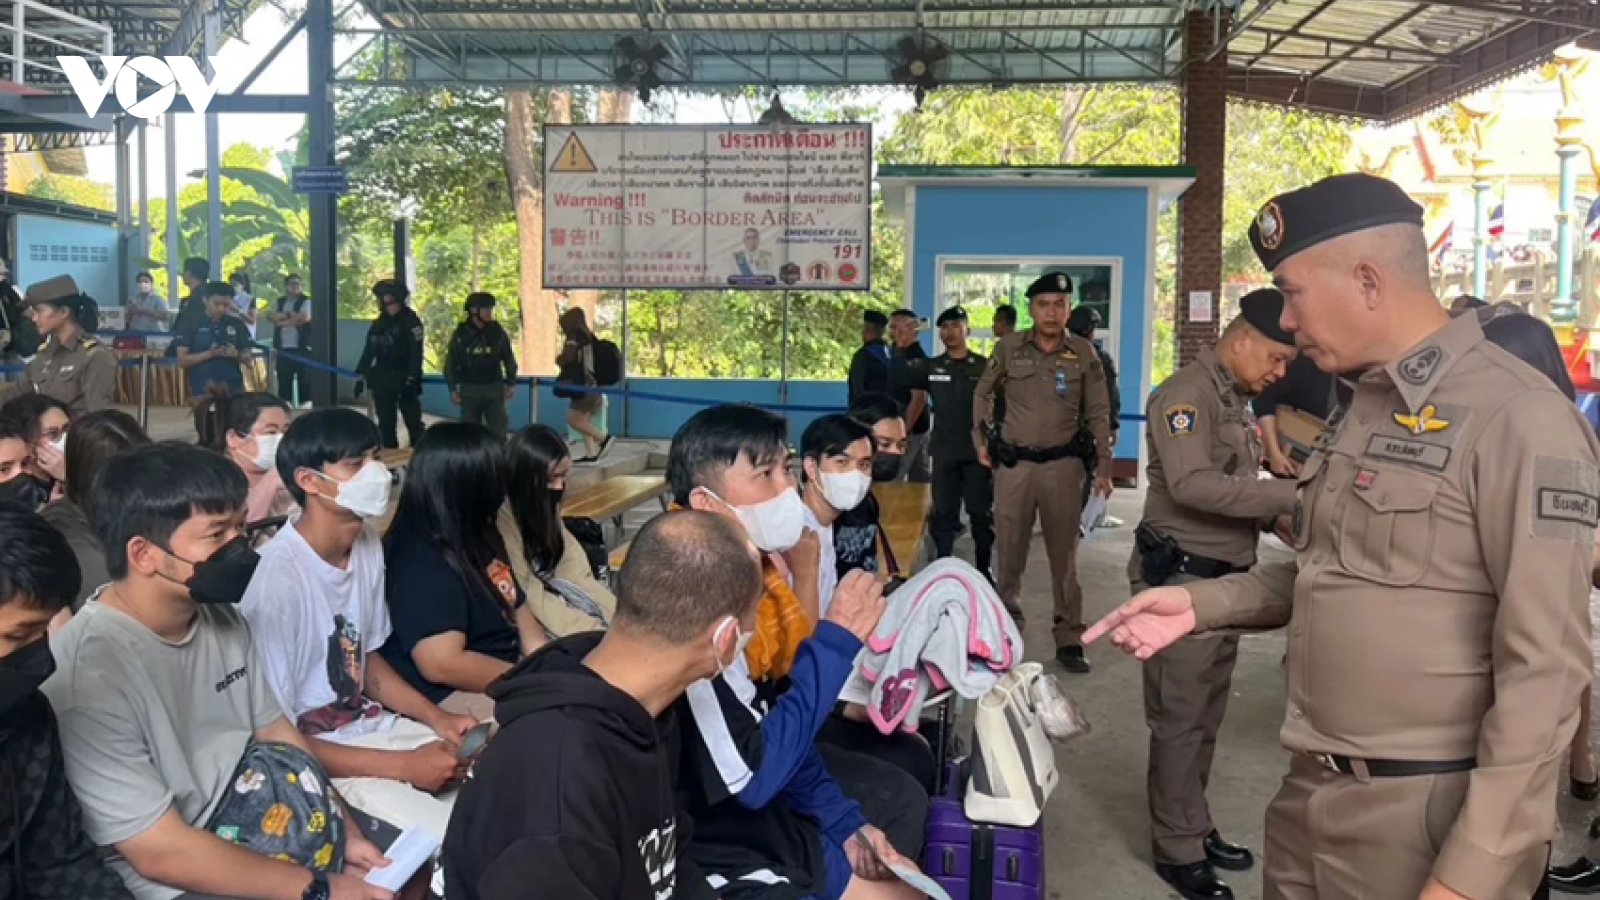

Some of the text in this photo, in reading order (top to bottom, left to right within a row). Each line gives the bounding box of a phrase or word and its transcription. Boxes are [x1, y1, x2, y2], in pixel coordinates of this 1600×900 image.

[718, 128, 836, 149] ประกาศเตือน
[553, 192, 624, 210] Warning
[833, 245, 863, 259] 191
